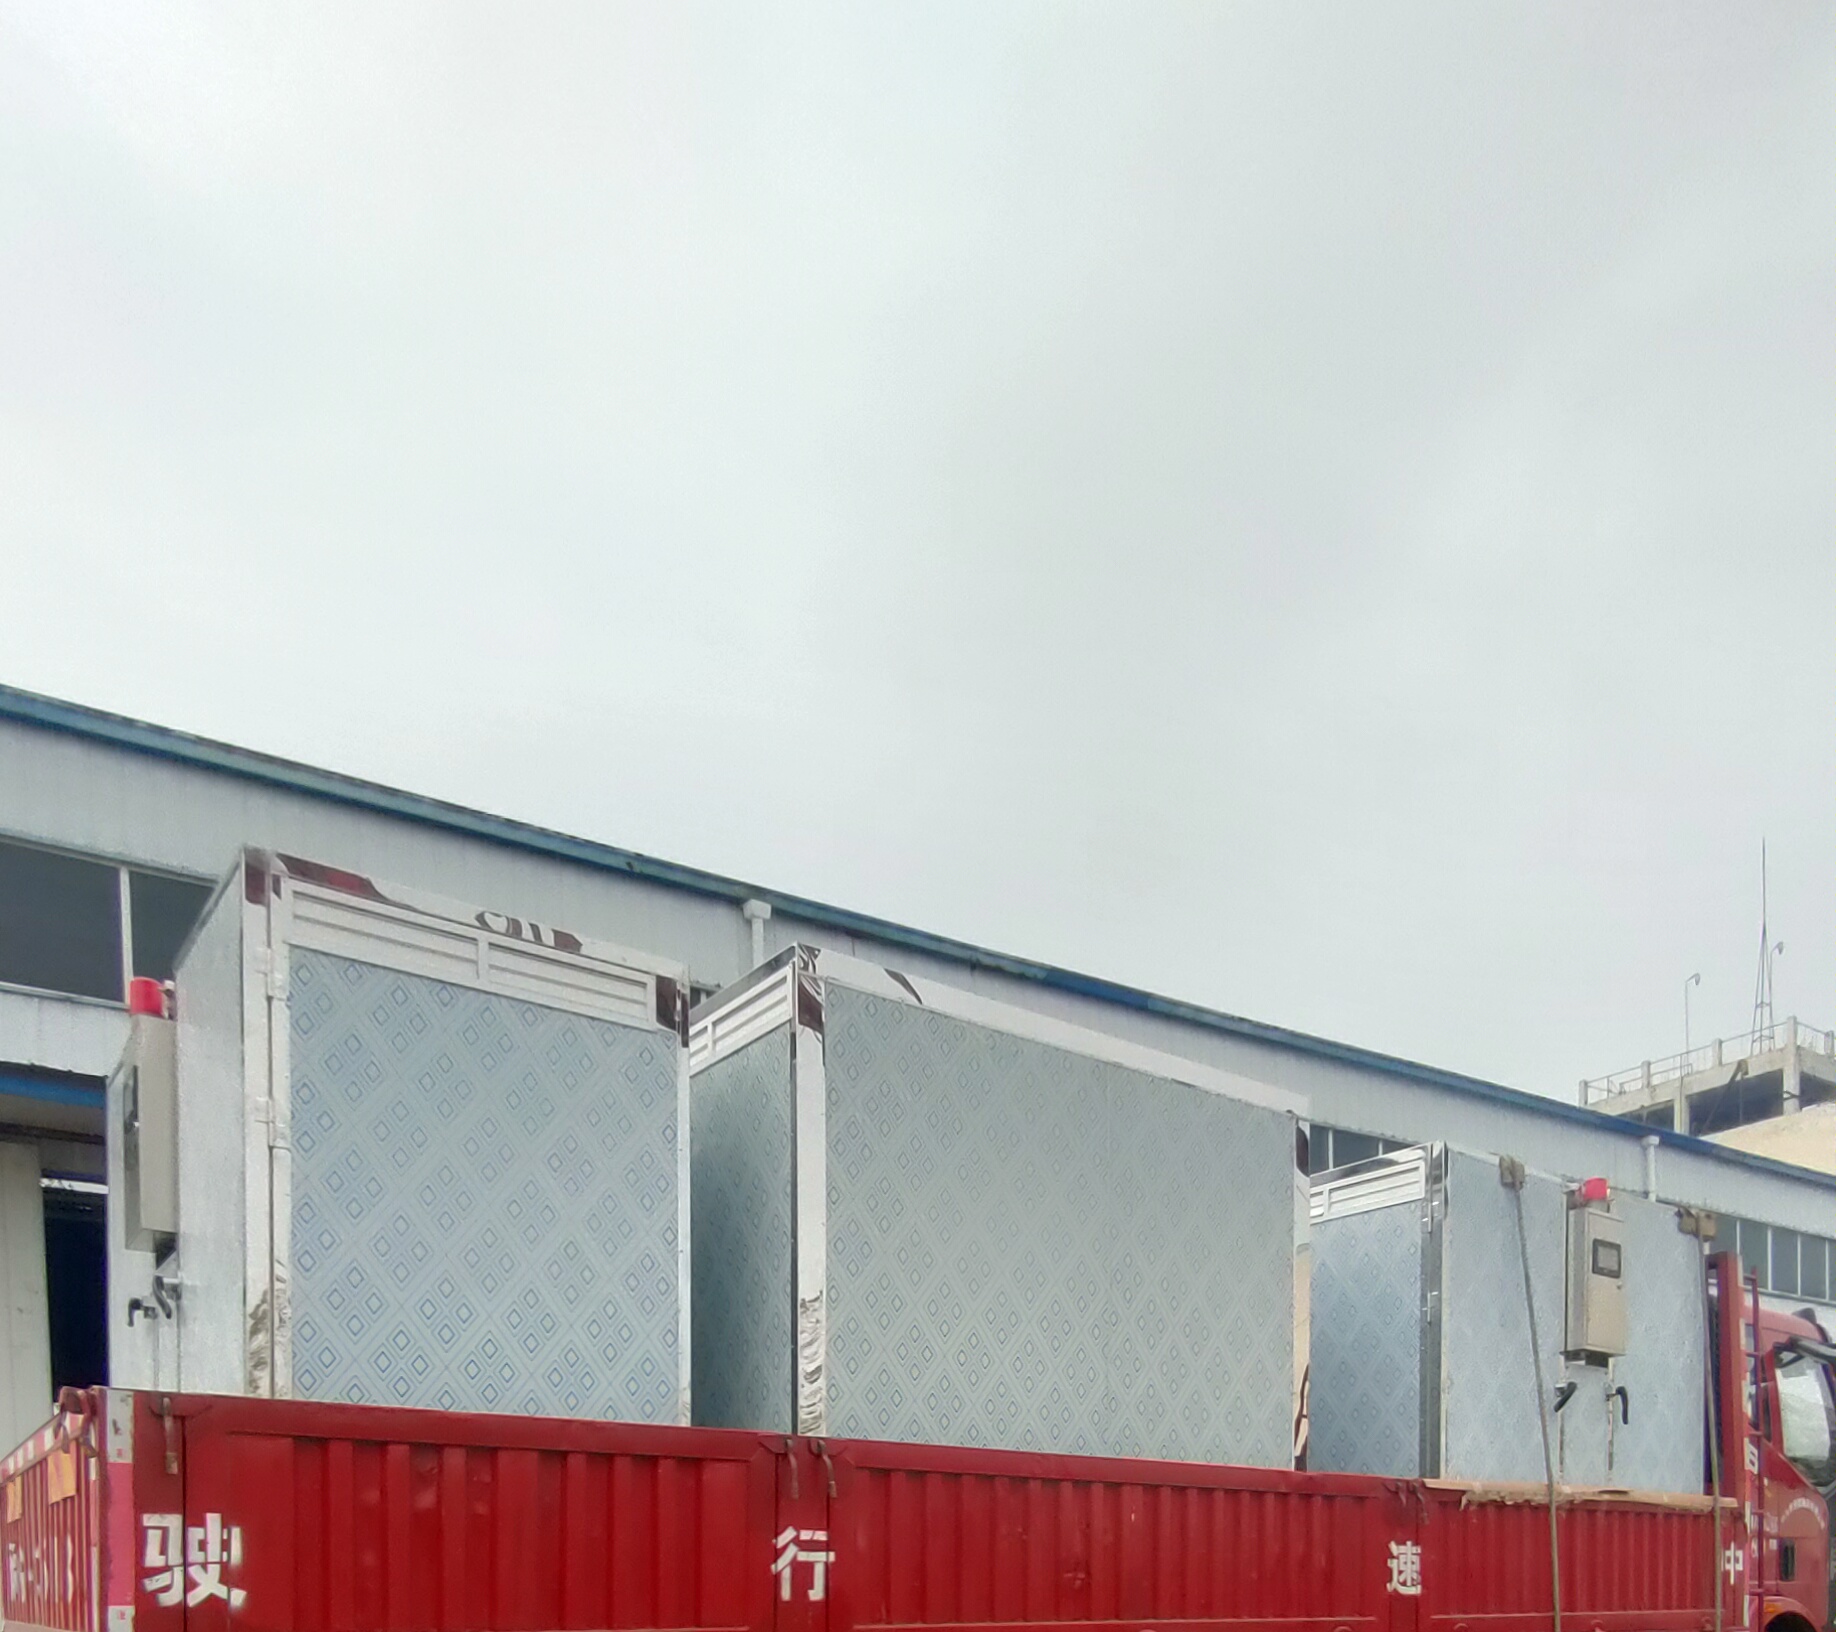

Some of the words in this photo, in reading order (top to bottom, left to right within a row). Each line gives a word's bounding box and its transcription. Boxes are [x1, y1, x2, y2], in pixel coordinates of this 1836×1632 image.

[142, 1512, 247, 1608] 驶
[771, 1526, 836, 1601] 行
[1386, 1540, 1422, 1595] 速
[1721, 1541, 1744, 1586] 中
